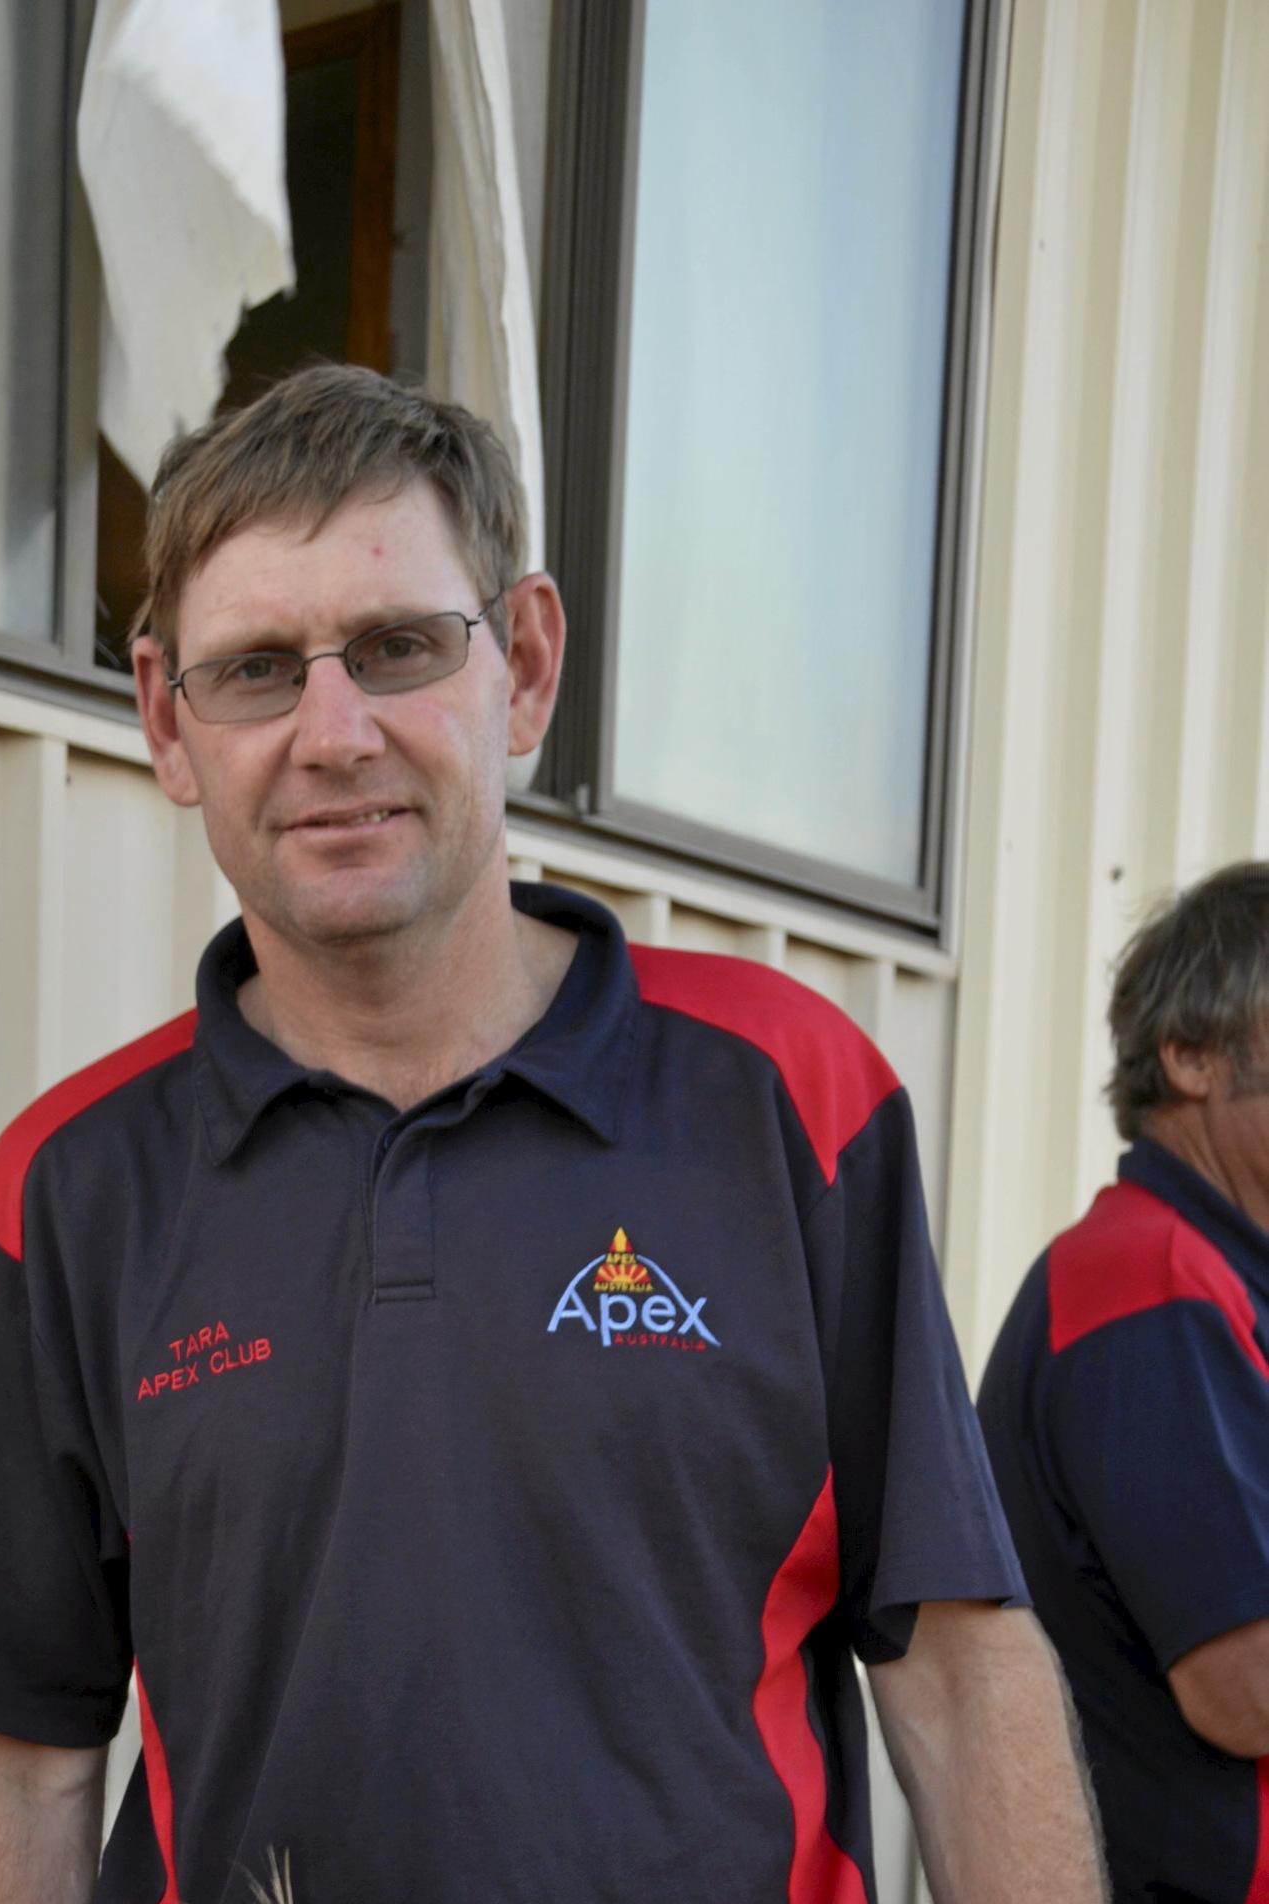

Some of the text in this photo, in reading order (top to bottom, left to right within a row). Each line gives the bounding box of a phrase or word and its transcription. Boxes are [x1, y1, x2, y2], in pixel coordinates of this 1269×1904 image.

[606, 1253, 636, 1264] APEX
[593, 1281, 653, 1292] AUSTRALIA
[546, 1284, 722, 1347] Apex
[169, 1320, 229, 1363] TARA
[614, 1332, 707, 1351] AUSTRALIA
[137, 1337, 272, 1401] APEX CLUB
